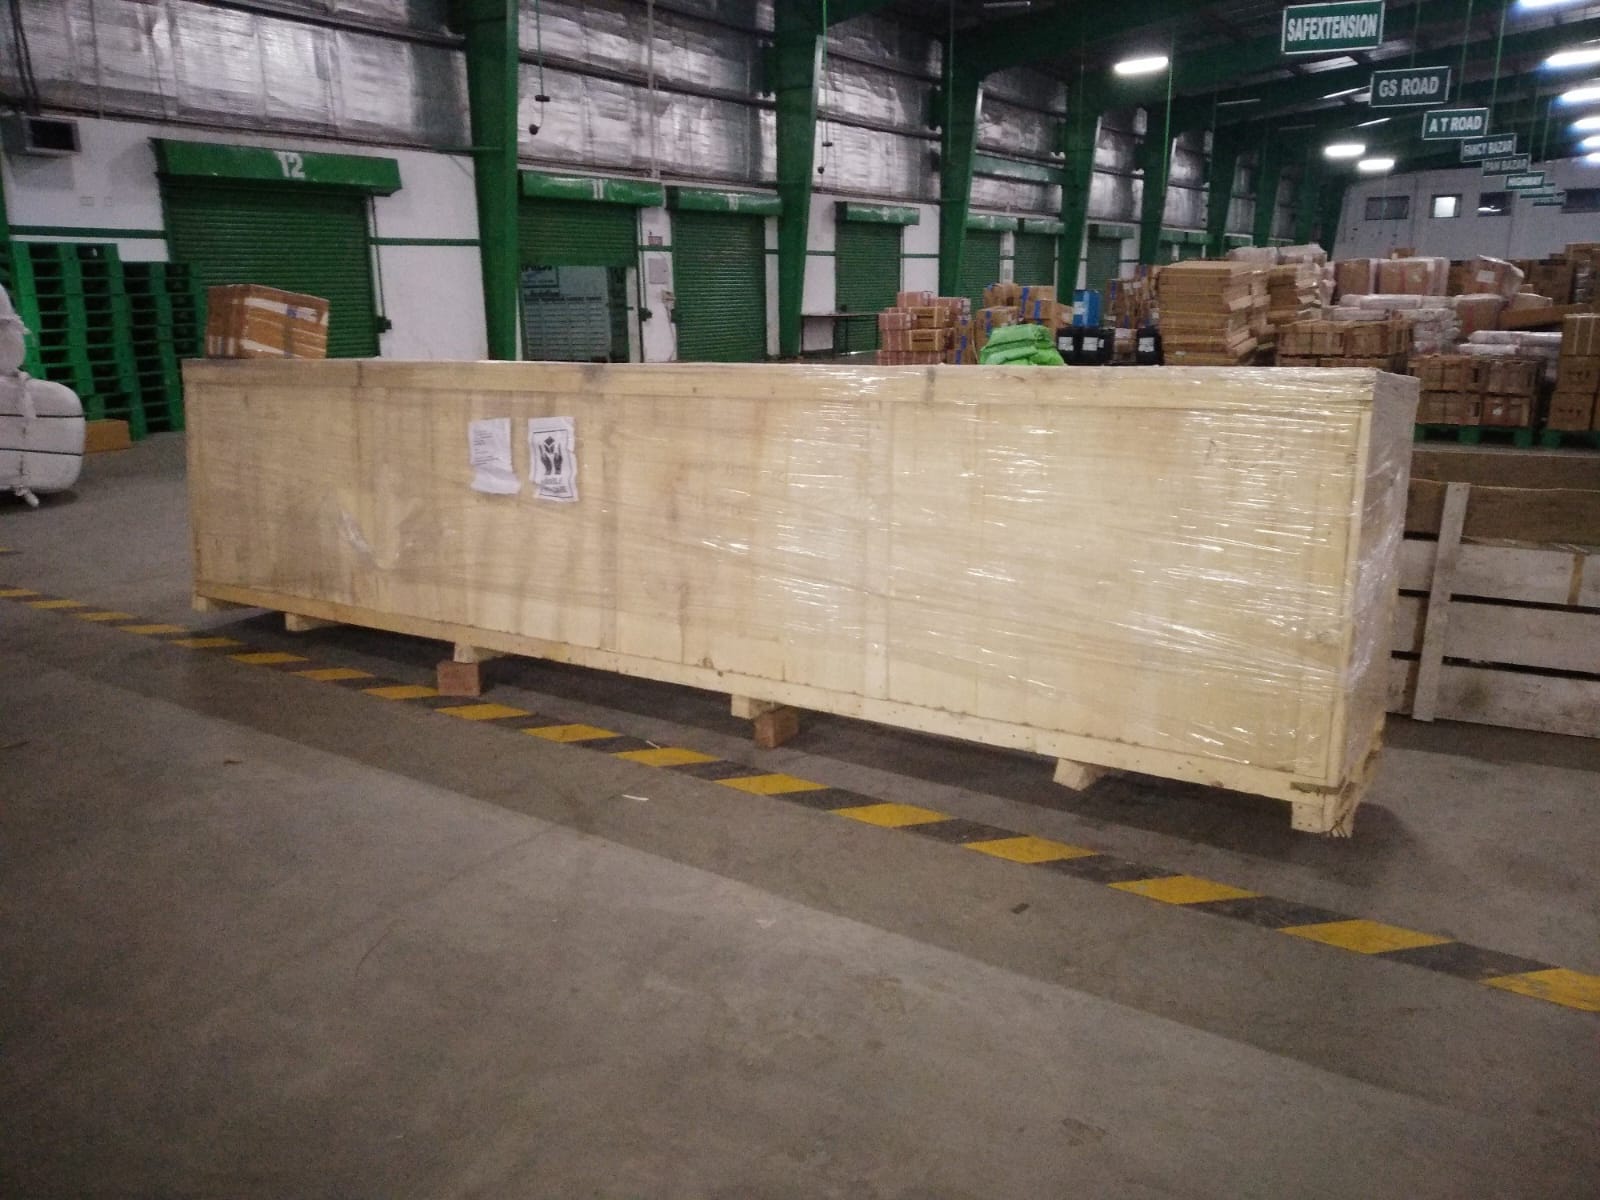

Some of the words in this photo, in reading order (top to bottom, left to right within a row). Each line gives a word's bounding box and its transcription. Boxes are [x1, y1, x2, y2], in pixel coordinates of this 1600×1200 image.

[1287, 14, 1378, 41] SAFEXTENSION
[1379, 79, 1398, 97] GS
[1400, 76, 1439, 96] ROAD
[1429, 118, 1438, 133] A
[1441, 117, 1449, 132] T
[1450, 115, 1482, 131] ROAD
[273, 150, 305, 178] 12
[592, 179, 604, 199] 11
